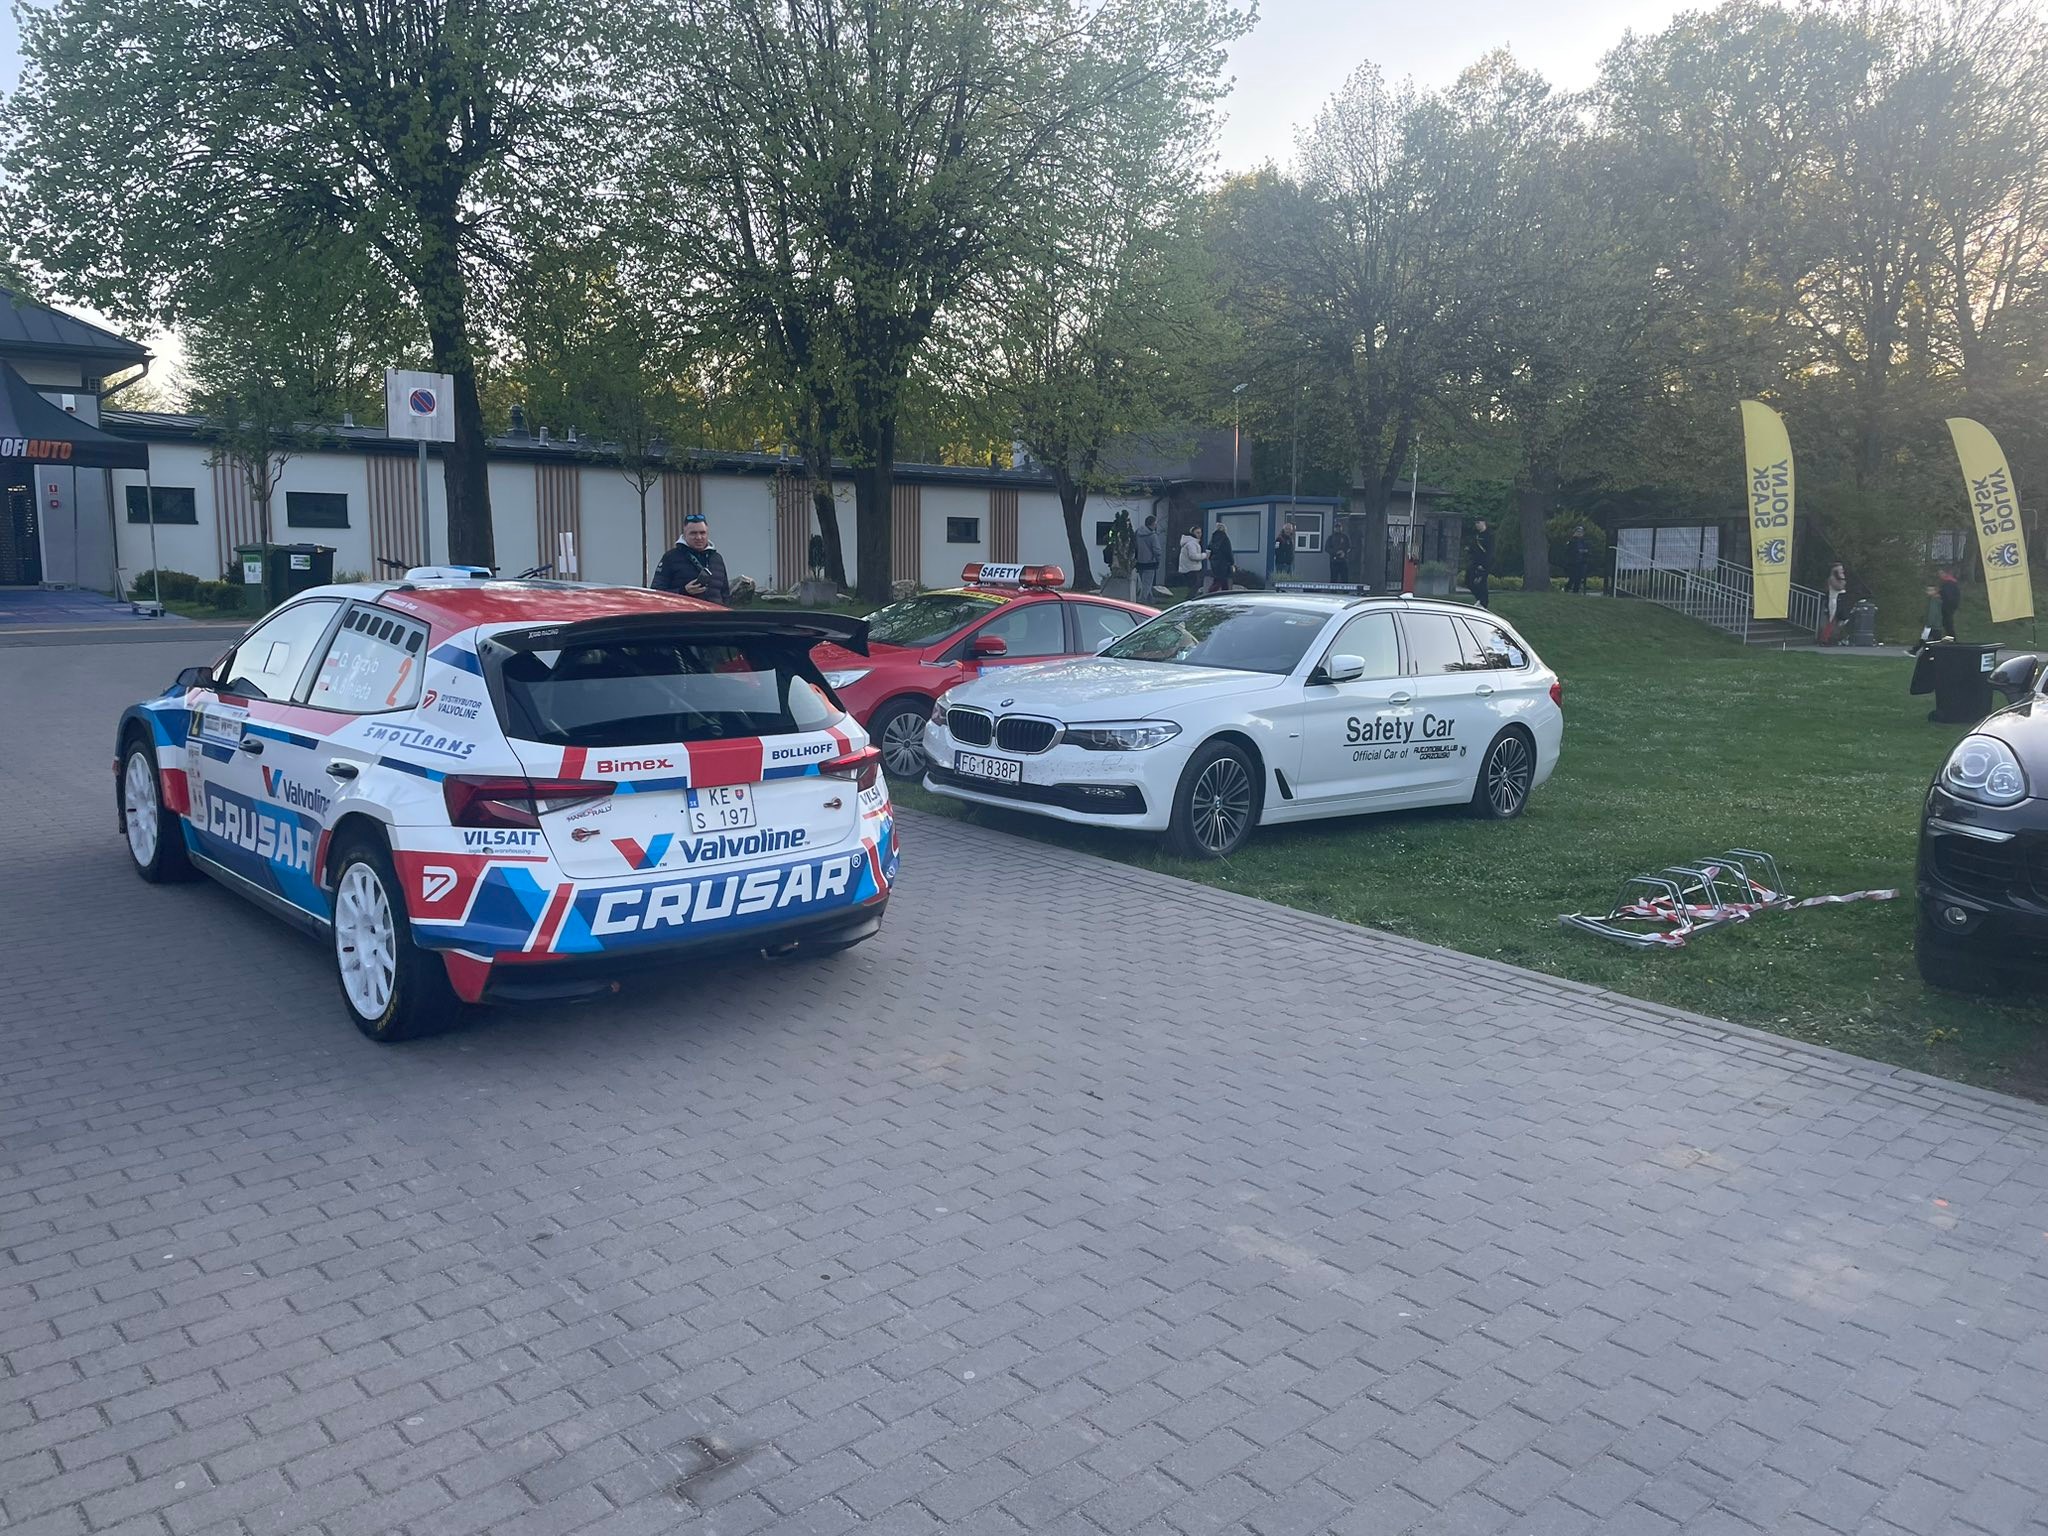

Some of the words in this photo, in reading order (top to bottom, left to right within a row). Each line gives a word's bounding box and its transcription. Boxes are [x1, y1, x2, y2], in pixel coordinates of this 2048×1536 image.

[0, 438, 73, 460] OFIAUTO
[981, 567, 1020, 578] SAFETY
[441, 694, 483, 709] DYSTRYBUTOR
[438, 703, 478, 720] VALVOLINE
[1346, 716, 1414, 744] Safety
[1422, 713, 1456, 738] Car
[1352, 749, 1382, 762] Official
[1384, 748, 1398, 760] Car
[1400, 748, 1409, 759] of
[597, 758, 674, 774] Bimex
[962, 754, 976, 772] FG
[981, 759, 1017, 779] 1838P
[709, 788, 731, 806] KE
[696, 813, 707, 829] S
[719, 808, 749, 828] 197
[209, 795, 313, 874] CRUSAR
[464, 831, 540, 846] VILSAIT
[679, 828, 806, 863] Valvoline
